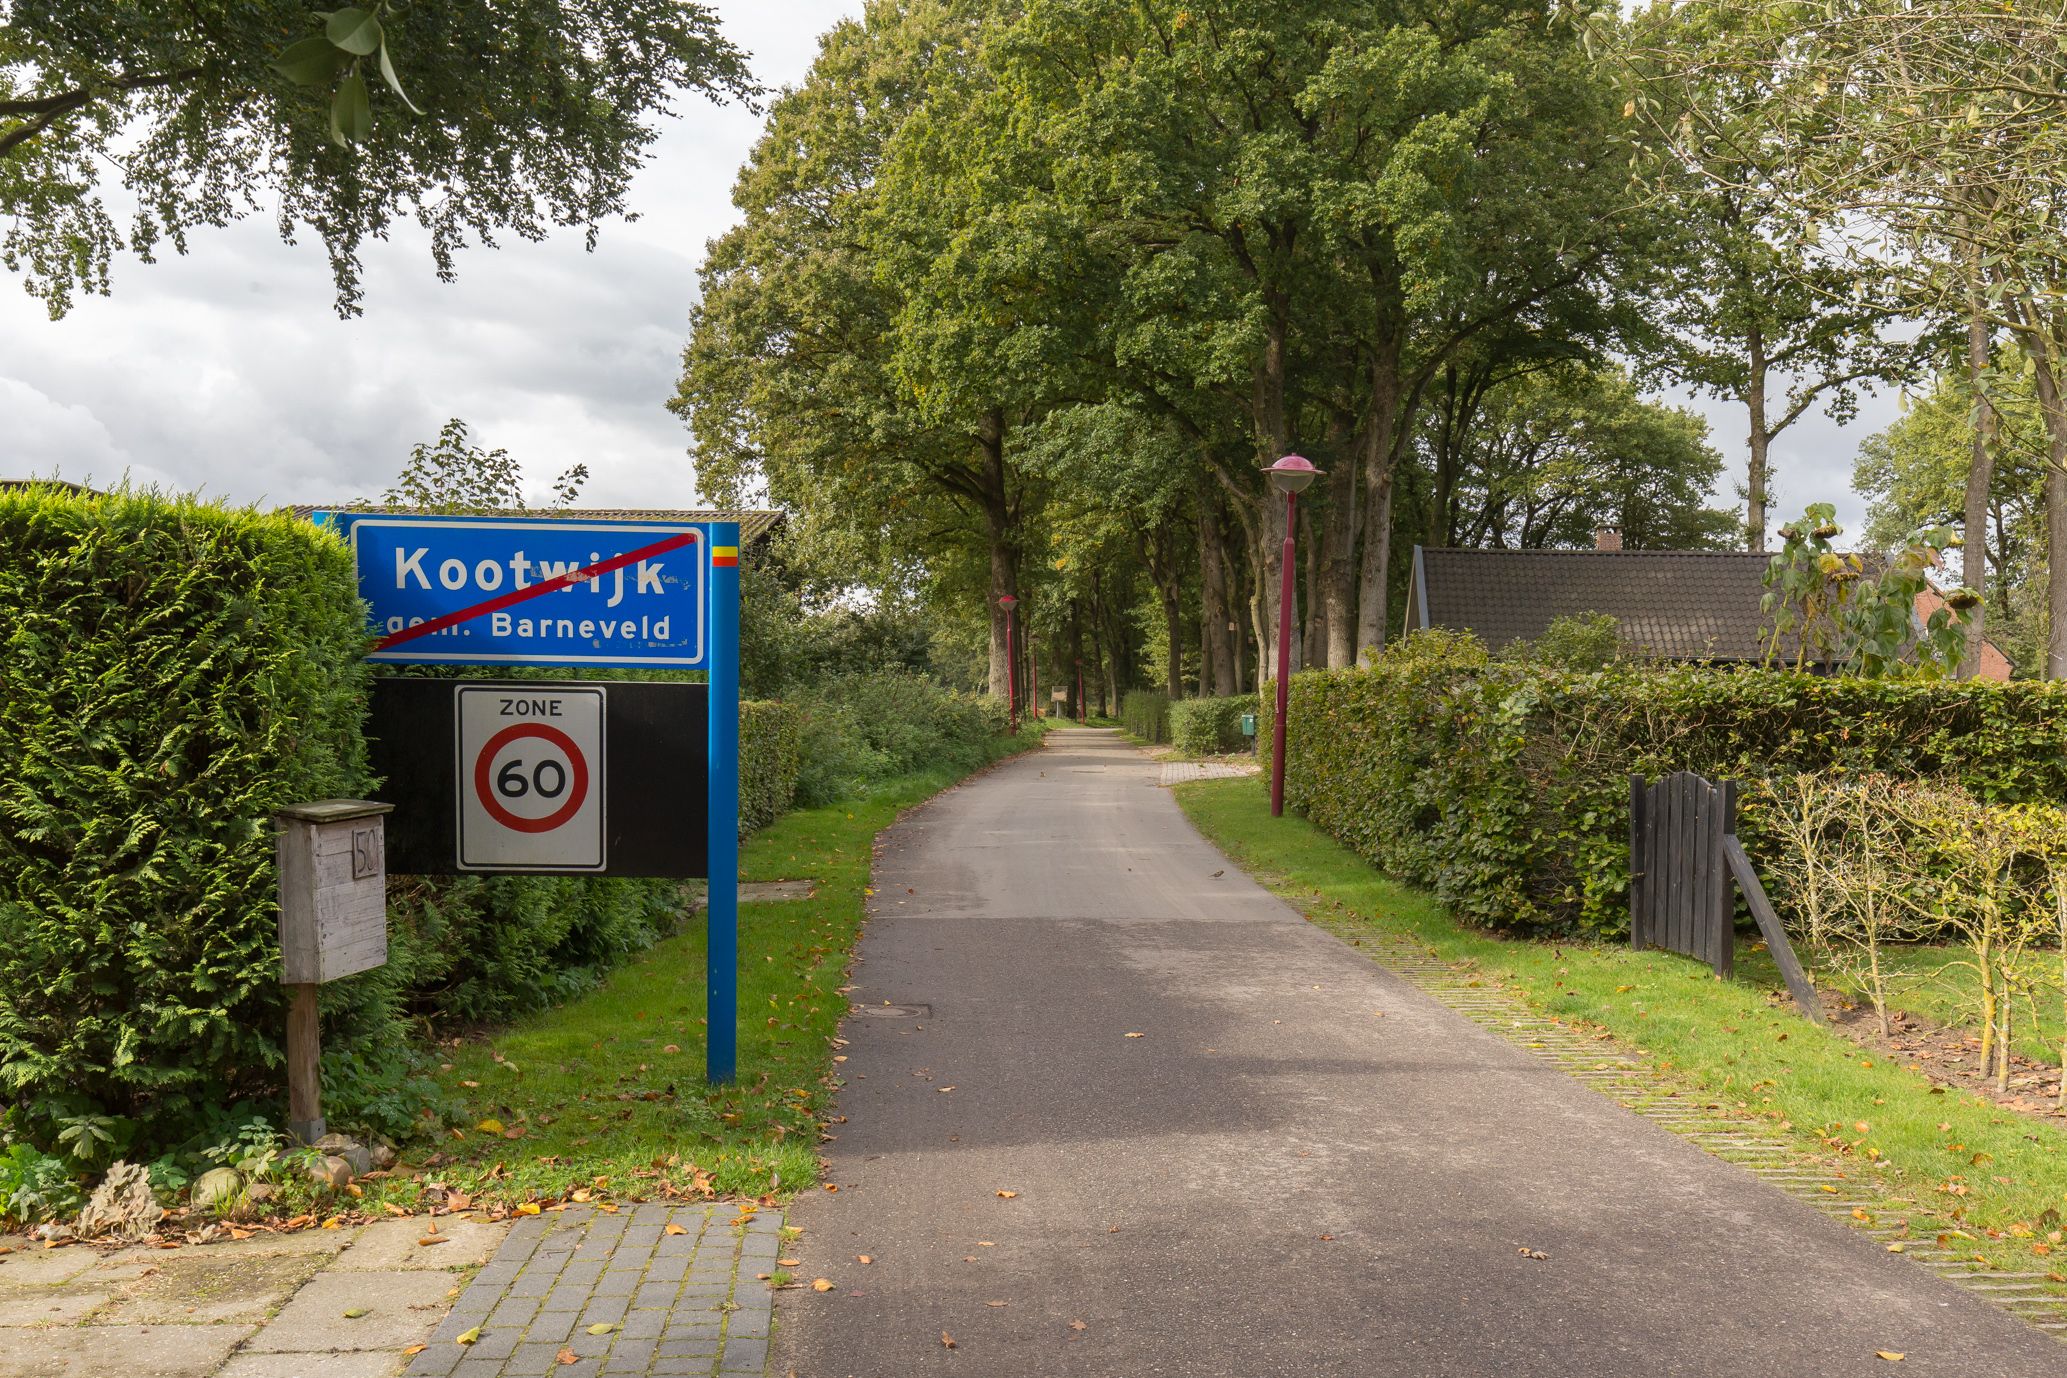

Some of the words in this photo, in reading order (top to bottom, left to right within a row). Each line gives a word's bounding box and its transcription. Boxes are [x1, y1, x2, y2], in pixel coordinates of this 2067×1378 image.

[395, 547, 665, 607] Kootwijk
[491, 612, 670, 640] Barneveld
[500, 699, 562, 716] ZONE
[497, 759, 566, 798] 60
[356, 829, 377, 873] 50
